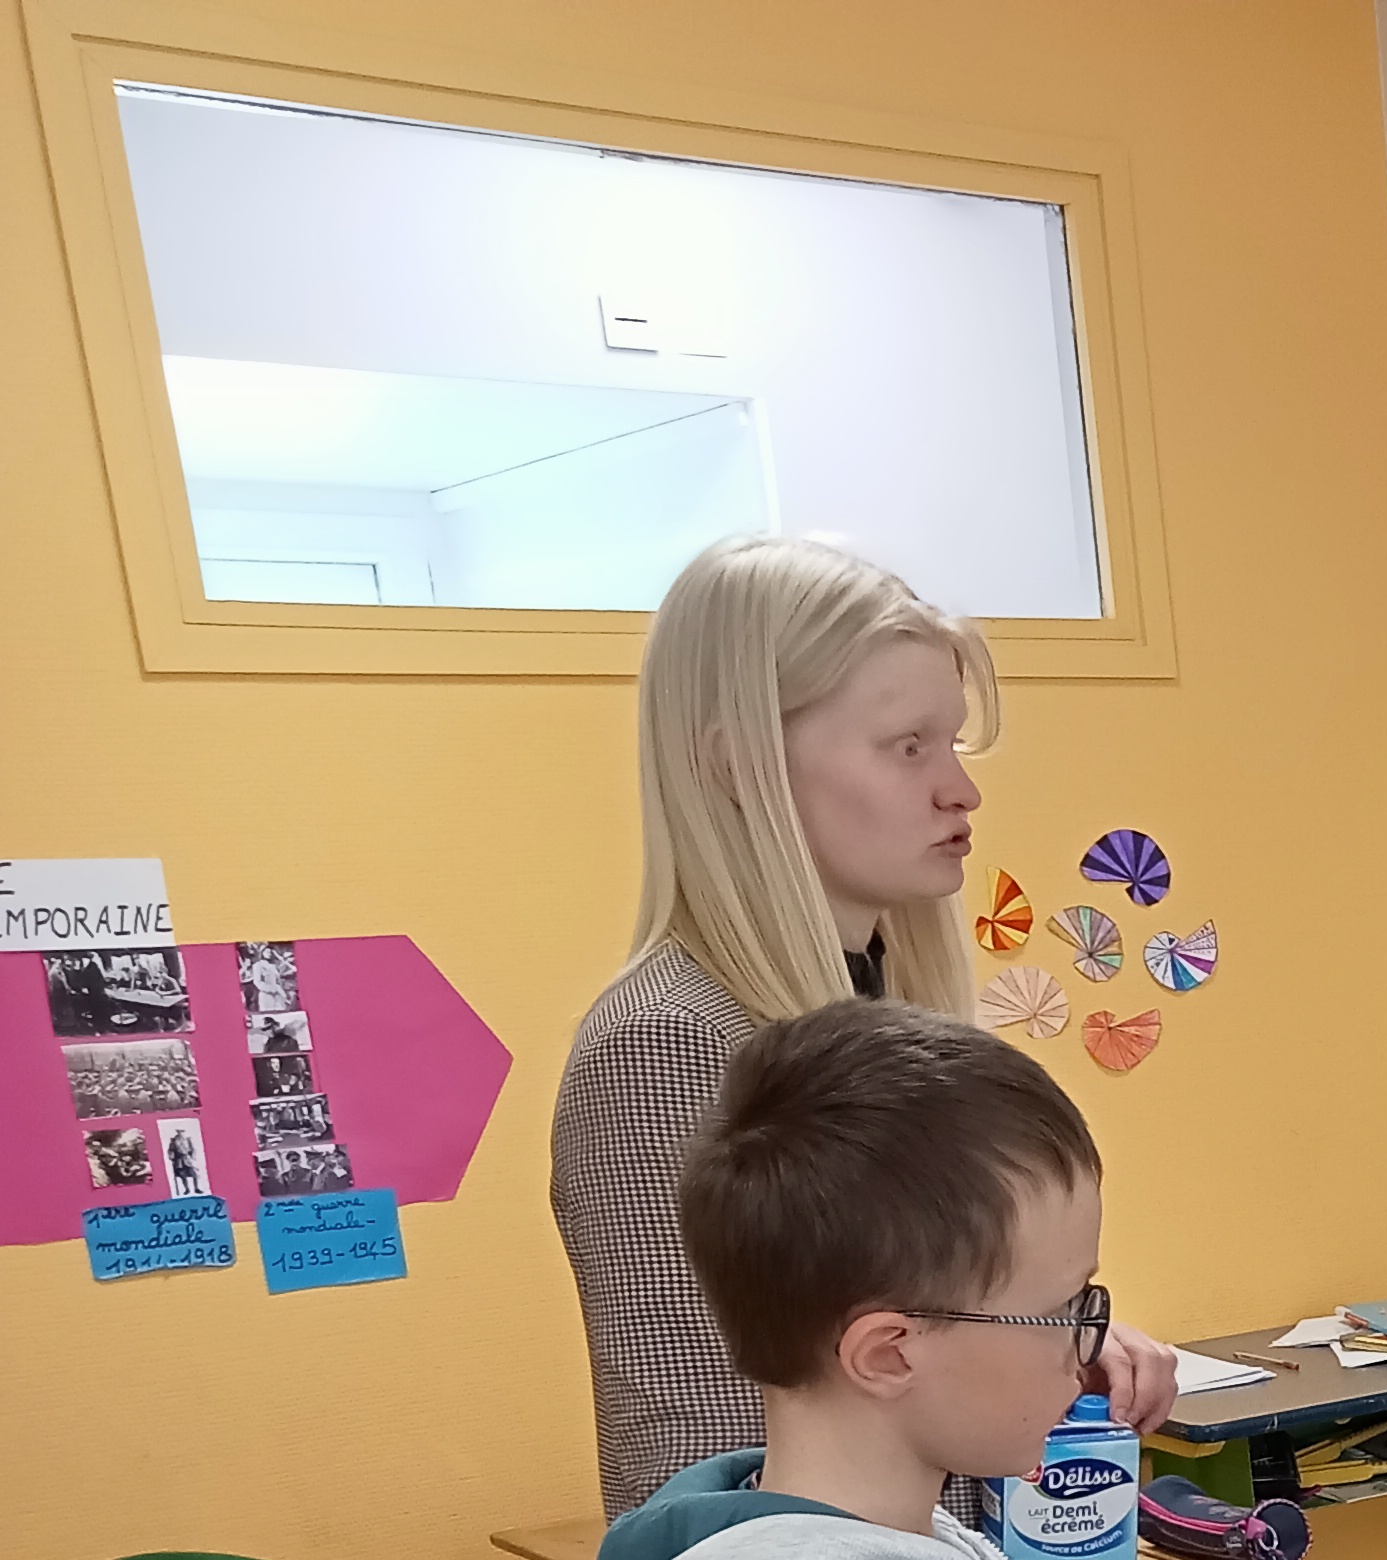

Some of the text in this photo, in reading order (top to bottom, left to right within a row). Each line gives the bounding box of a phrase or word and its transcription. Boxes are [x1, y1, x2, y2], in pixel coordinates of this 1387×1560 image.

[149, 1203, 228, 1228] guerre
[311, 1197, 366, 1213] guerre
[95, 1222, 217, 1253] mondiale
[271, 1237, 397, 1274] 1939-1945
[1045, 1466, 1124, 1490] Délisse
[1027, 1500, 1100, 1520] LAIT Demi
[1040, 1515, 1106, 1535] écrémé
